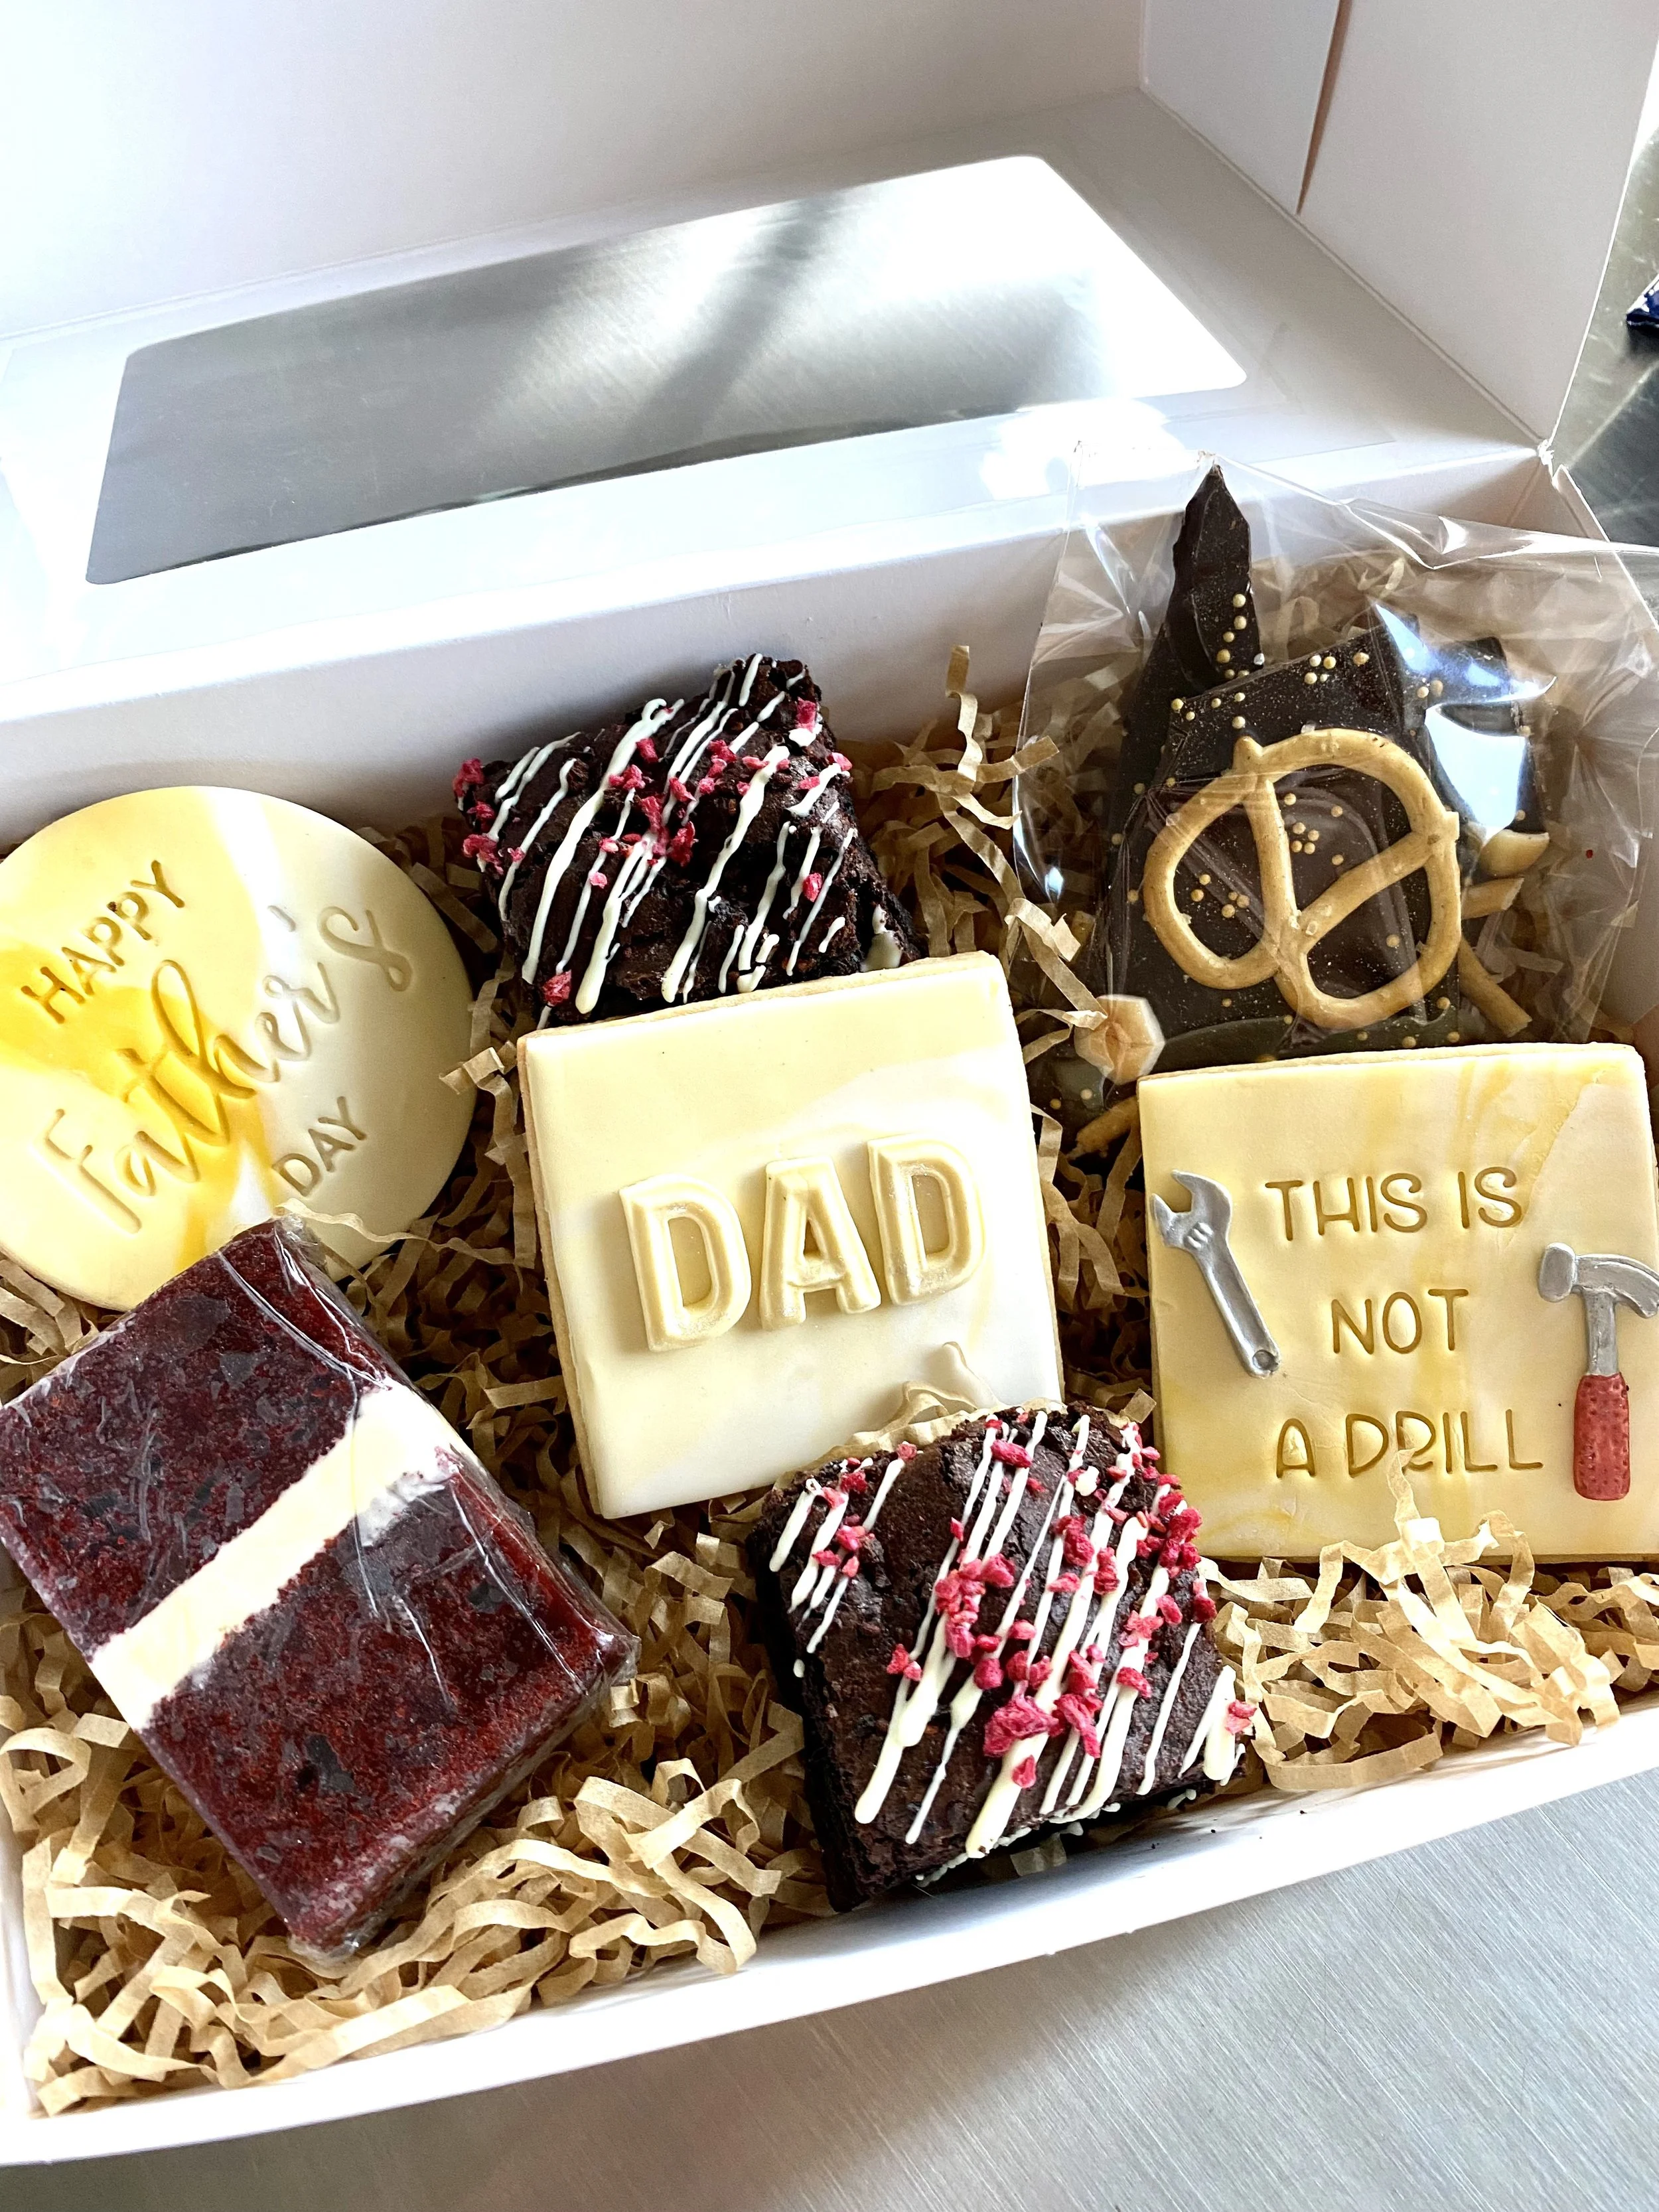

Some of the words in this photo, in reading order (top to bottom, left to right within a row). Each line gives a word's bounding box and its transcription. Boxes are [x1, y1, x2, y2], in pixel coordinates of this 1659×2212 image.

[21, 859, 185, 1024] HAPPY
[42, 904, 412, 1234] Father's
[271, 1096, 367, 1197] DAY
[618, 1133, 987, 1353] DAD
[1265, 1172, 1428, 1241] THIS
[1457, 1166, 1522, 1229] IS
[1330, 1288, 1469, 1355] NOT
[1276, 1418, 1316, 1479] A
[1346, 1408, 1544, 1478] DRILL
